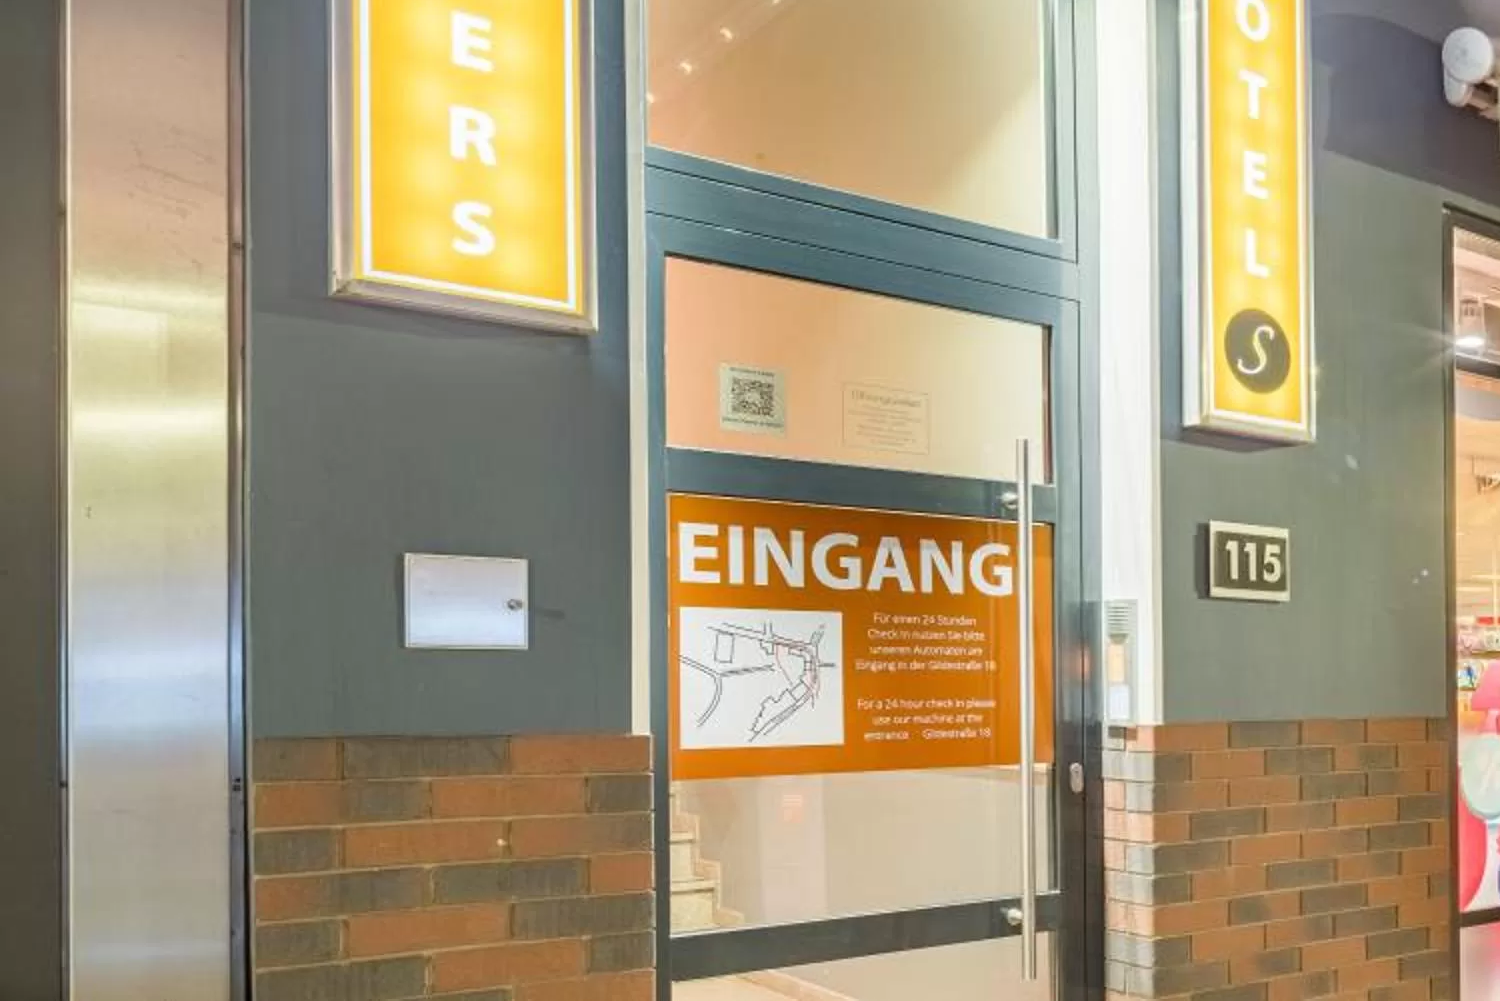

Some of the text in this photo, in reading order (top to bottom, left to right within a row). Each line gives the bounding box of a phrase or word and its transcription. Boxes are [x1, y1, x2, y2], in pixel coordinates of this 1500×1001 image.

[678, 521, 1014, 597] EINGANG
[1226, 540, 1282, 583] 115
[873, 611, 891, 624] Für
[936, 614, 977, 627] Stunden
